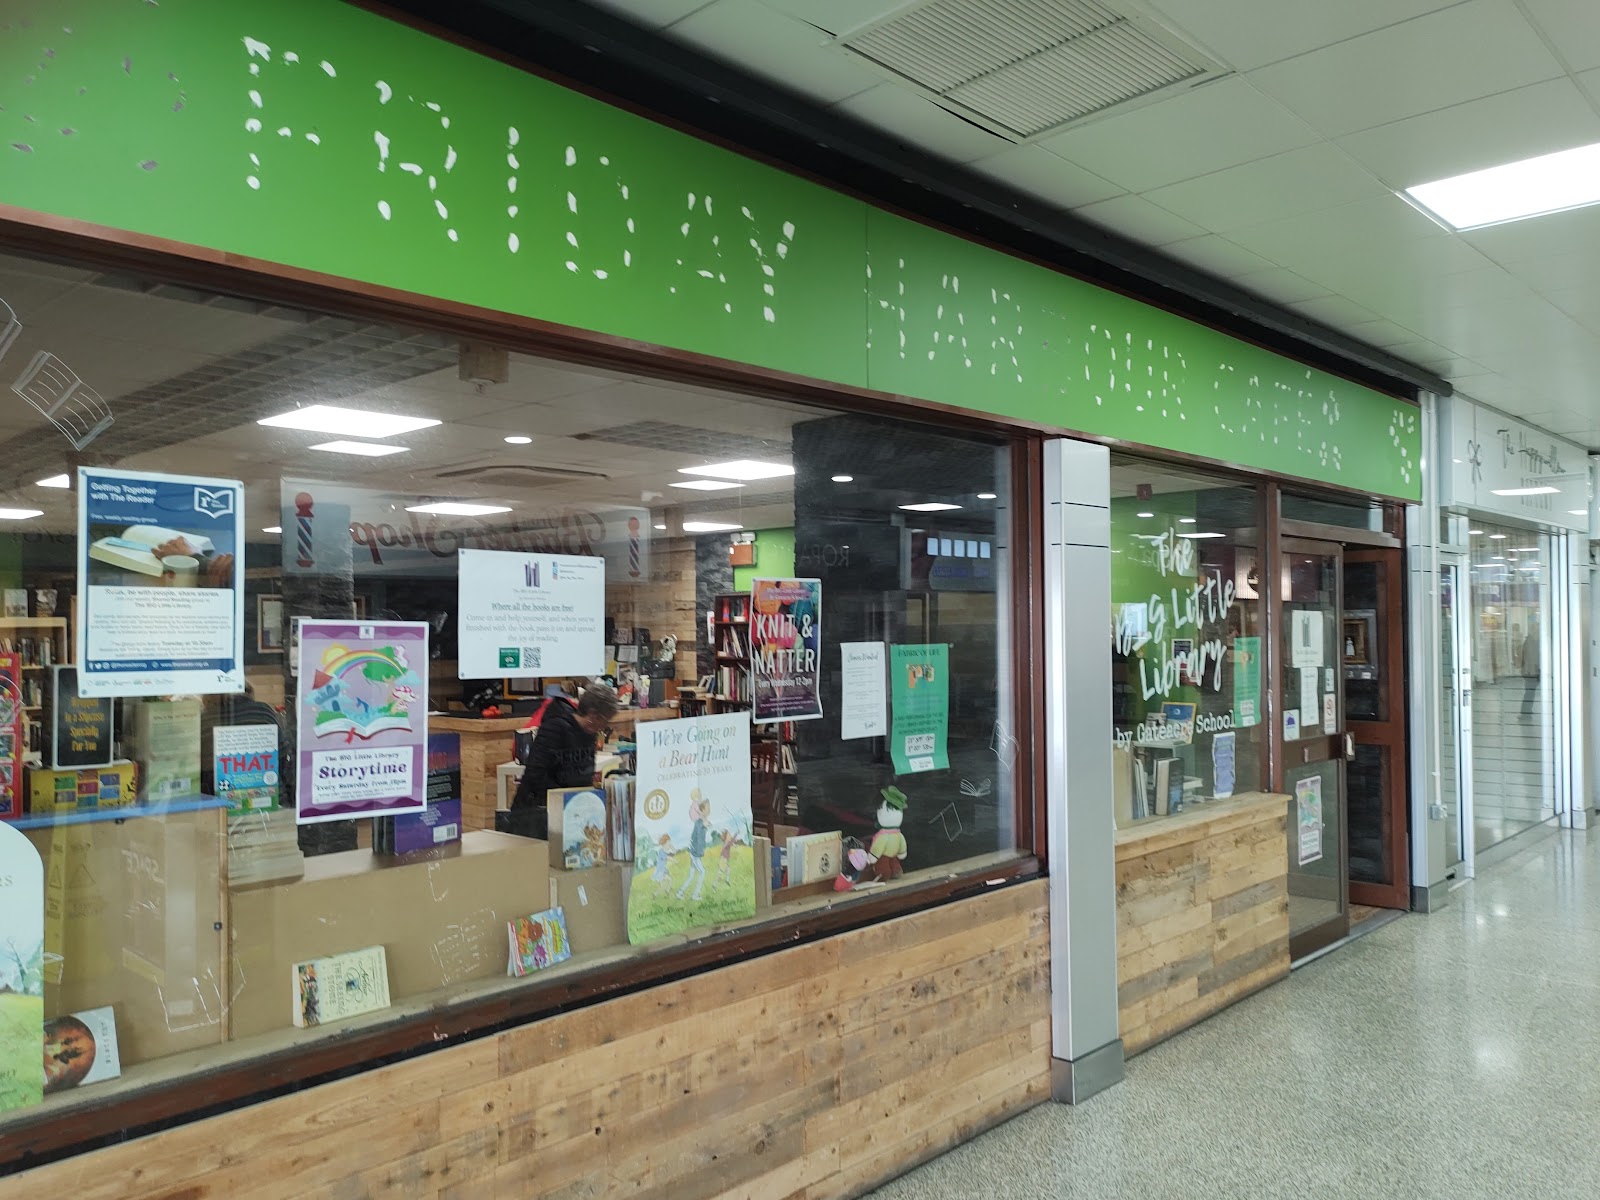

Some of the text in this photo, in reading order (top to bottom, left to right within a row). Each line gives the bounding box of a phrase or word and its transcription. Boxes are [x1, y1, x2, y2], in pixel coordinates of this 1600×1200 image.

[91, 482, 157, 495] Getting Together
[110, 493, 125, 502] The
[126, 494, 155, 504] Reader
[1151, 527, 1195, 577] The
[491, 603, 512, 611] Where
[512, 603, 520, 611] all
[521, 603, 531, 611] the
[532, 604, 550, 612] books
[1171, 569, 1237, 630] Little
[508, 614, 521, 623] help
[536, 626, 549, 634] pass
[577, 626, 596, 634] spread
[757, 613, 813, 639] KNIT &
[754, 649, 815, 674] NATTER
[1139, 638, 1227, 702] Library
[652, 725, 737, 748] We're Going on
[1115, 709, 1236, 749] by Gateacre School
[219, 754, 274, 774] THAT.
[659, 744, 730, 769] a Bear Hunt
[319, 762, 408, 780] Storytime
